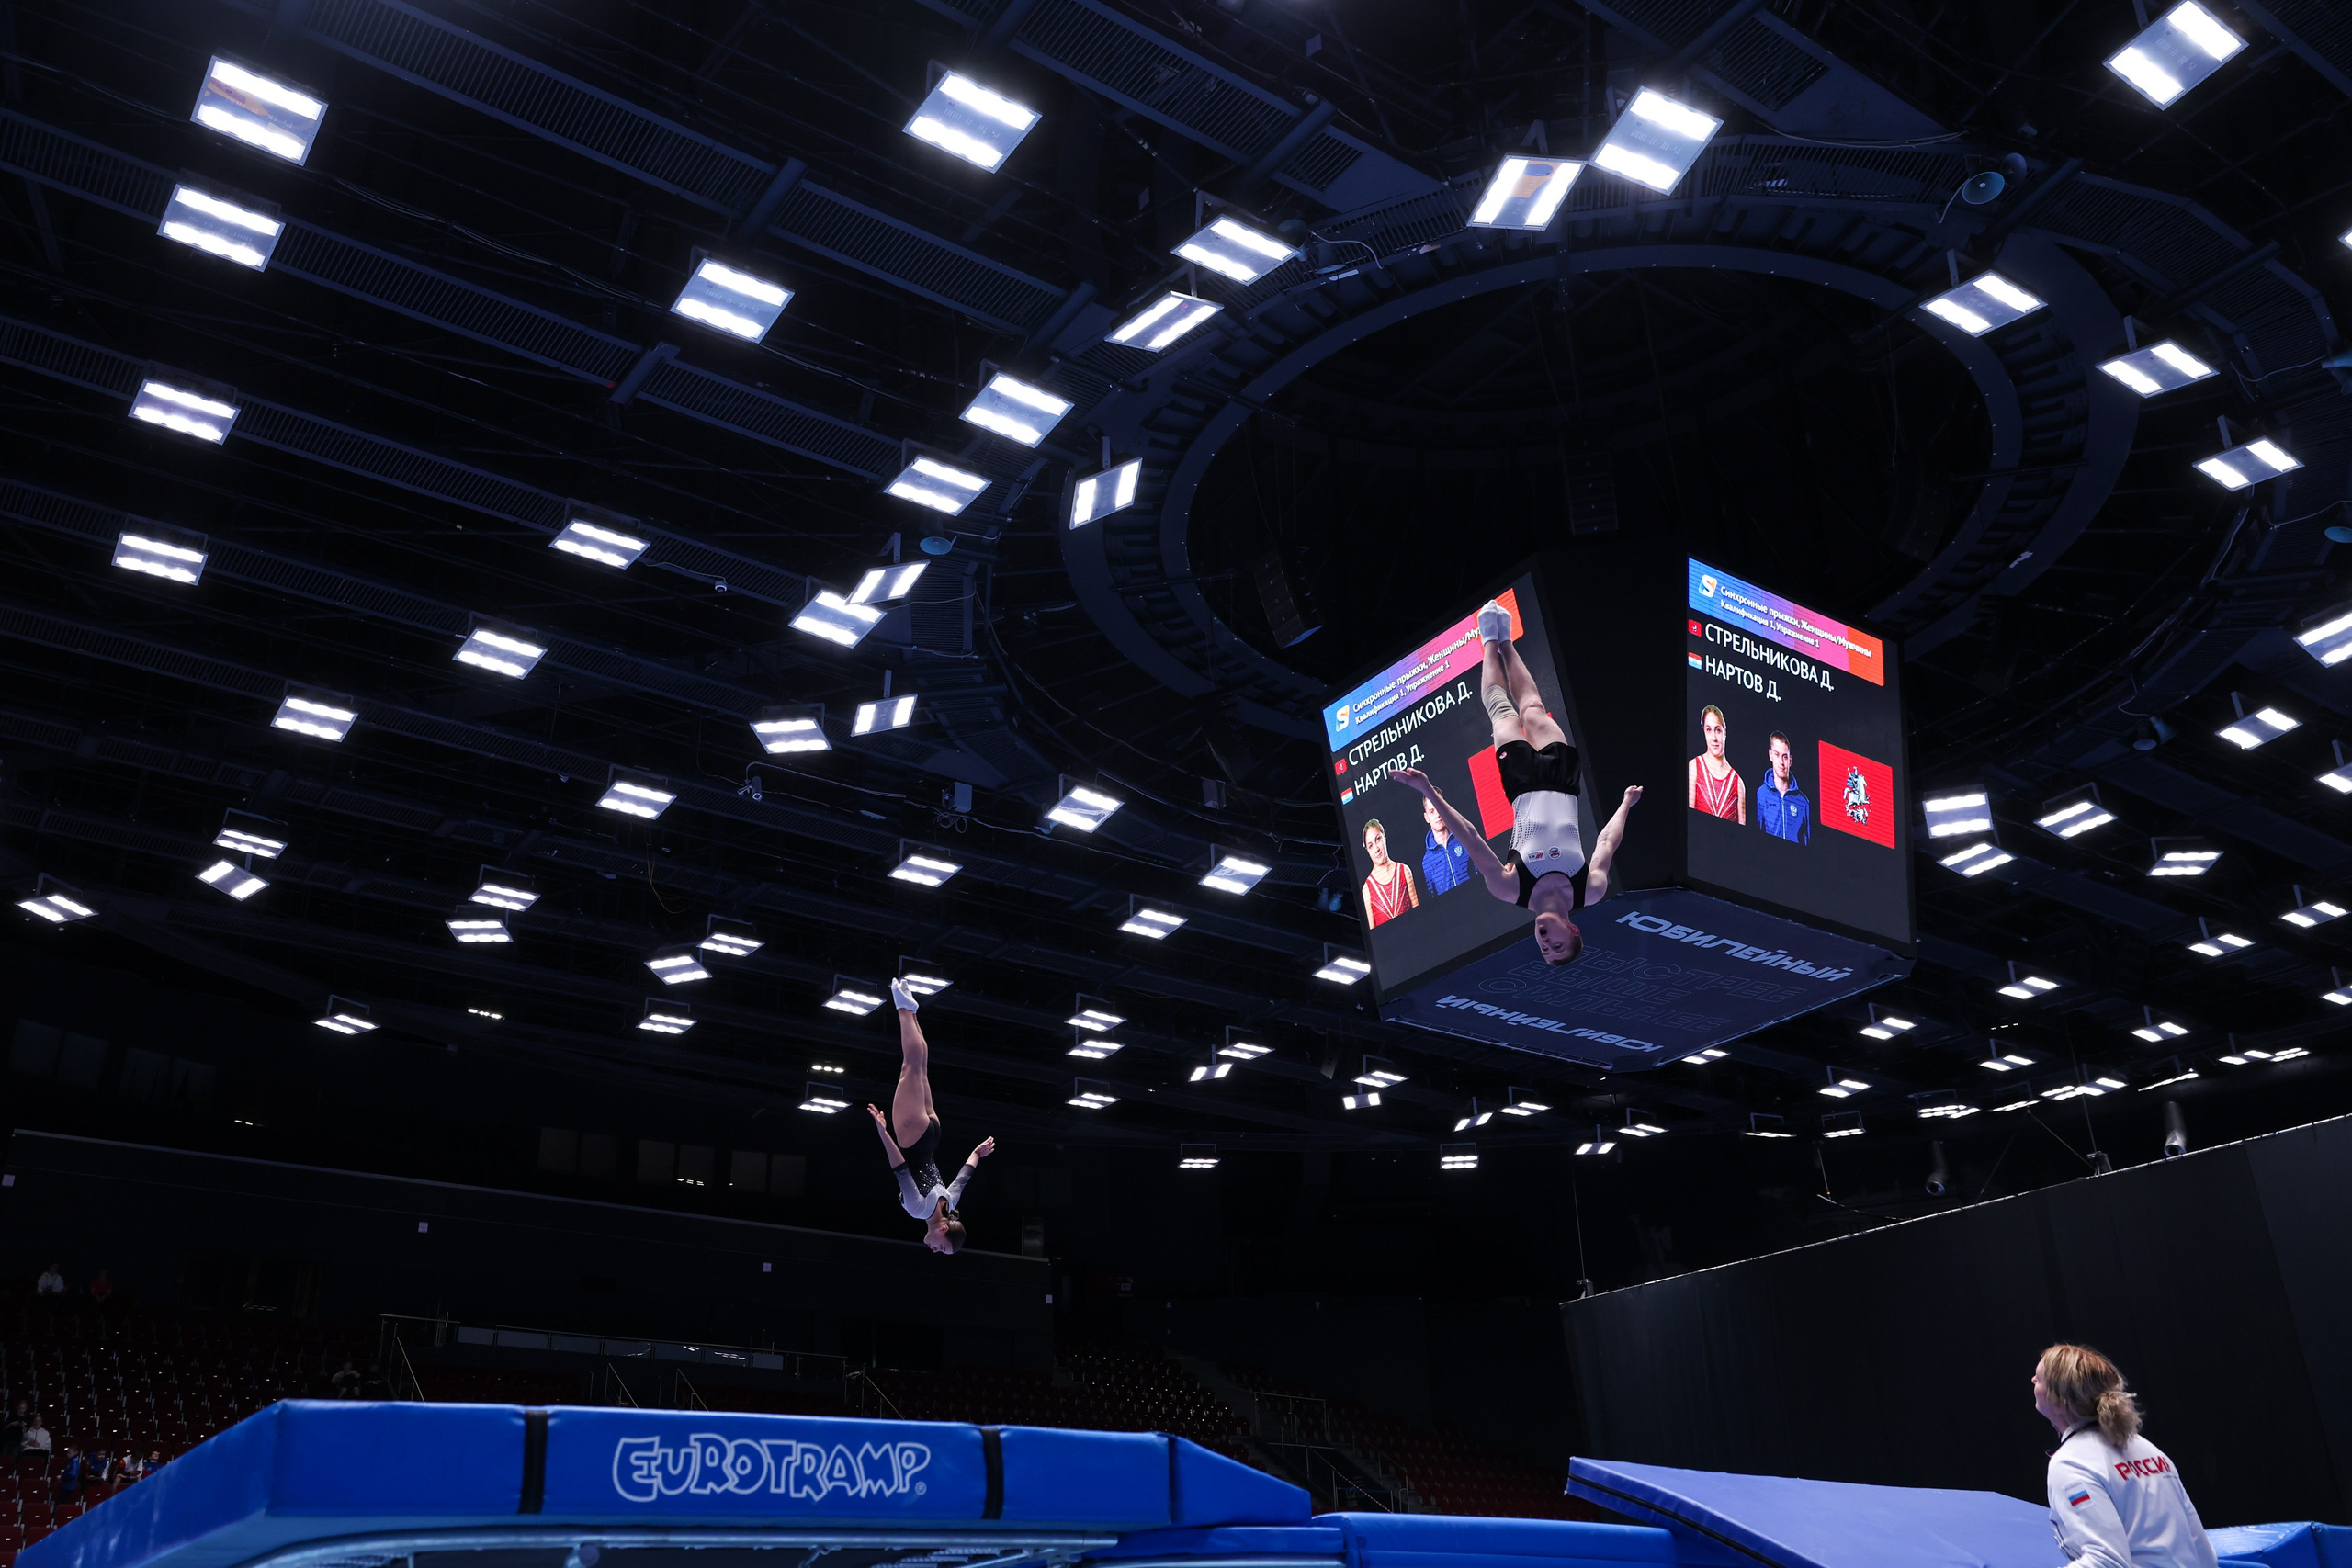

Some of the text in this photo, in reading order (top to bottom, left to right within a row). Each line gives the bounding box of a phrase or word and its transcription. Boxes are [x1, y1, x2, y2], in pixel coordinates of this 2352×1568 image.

[1720, 586, 1768, 614] Синхронные
[1801, 619, 1871, 658] Женщины/Мужчины
[1720, 599, 1769, 626] Квалификация
[1775, 622, 1815, 645] Упражнение
[1352, 681, 1396, 713] Синхронные
[1427, 627, 1481, 666] Женщины/Му
[1705, 623, 1835, 692] СТРЕЛЬНИКОВА Д.
[1705, 654, 1781, 702] НАРТОВ Д.
[1348, 681, 1473, 766] СТРЕЛЬНИКОВА Д.
[1354, 693, 1399, 725] Квалификация
[1405, 664, 1445, 694] Упражнение
[1354, 744, 1425, 796] НАРТОВ Д.
[1615, 911, 1854, 982] ЮБИЛЕЙНЫЙ
[1435, 994, 1664, 1053] ЮБИЛЕЙНЫЙ
[1478, 977, 1733, 1032] СИЛЬНЕЕ
[612, 1433, 931, 1502] EUROTRAMP
